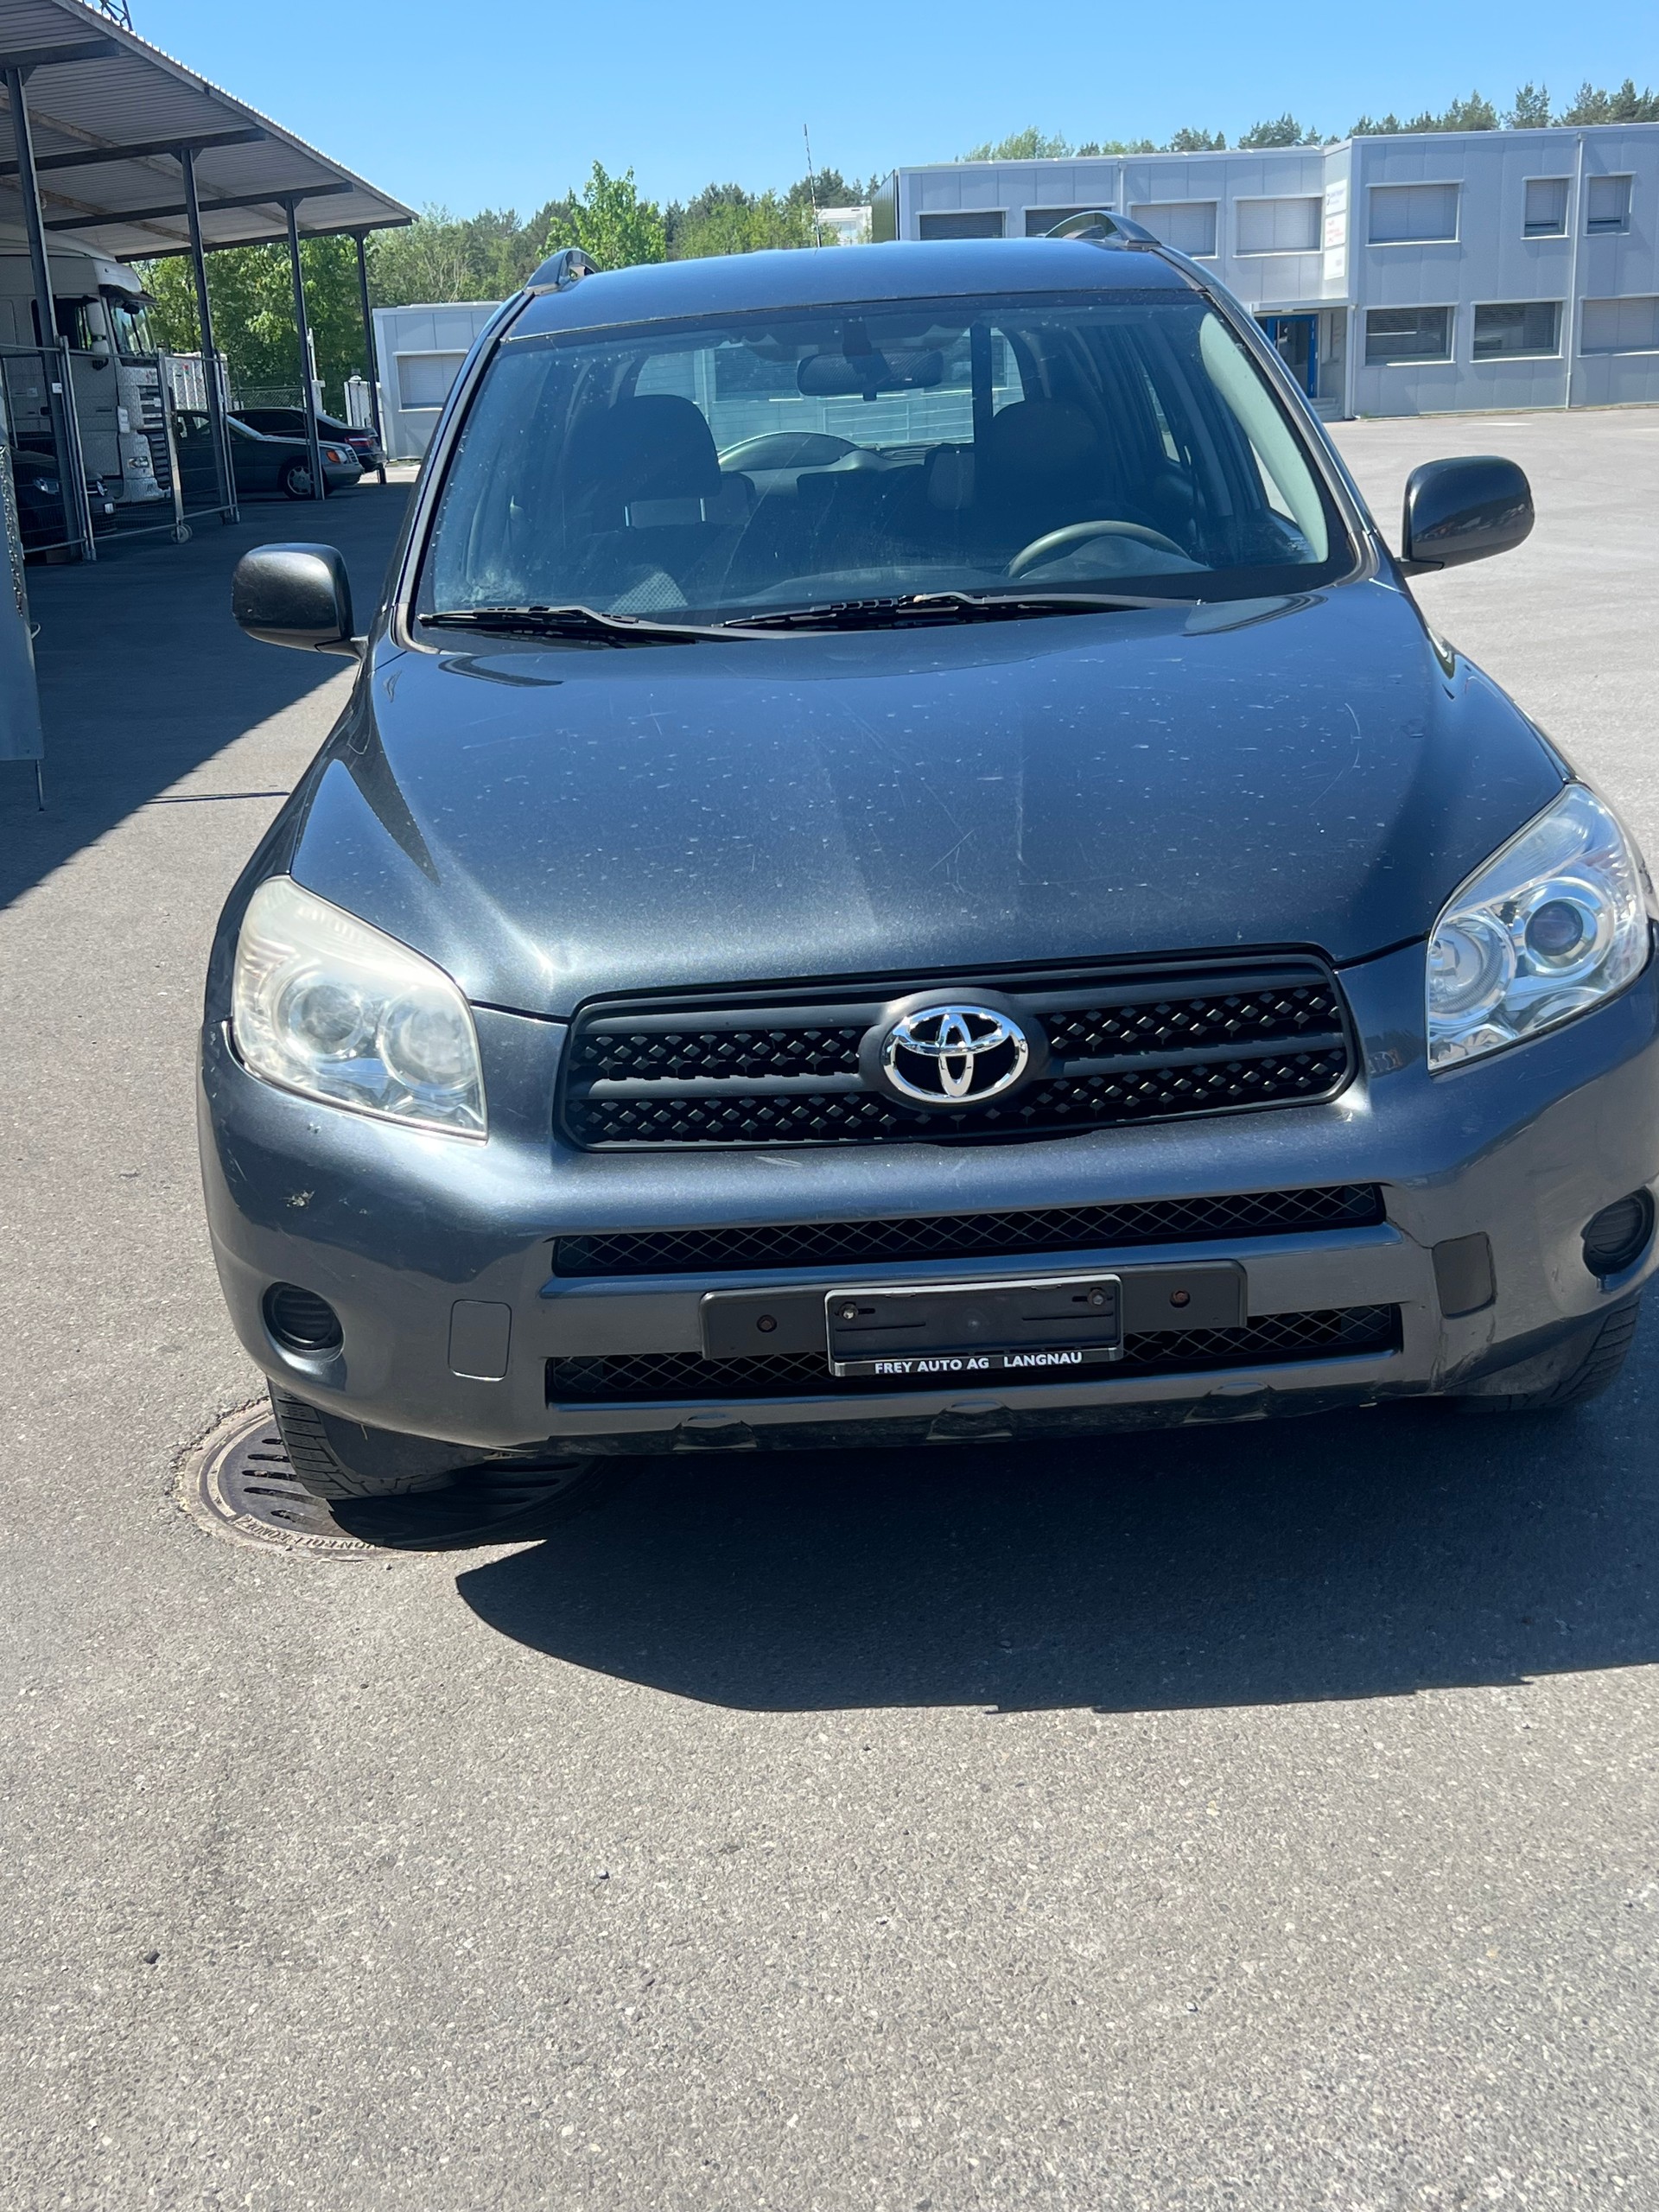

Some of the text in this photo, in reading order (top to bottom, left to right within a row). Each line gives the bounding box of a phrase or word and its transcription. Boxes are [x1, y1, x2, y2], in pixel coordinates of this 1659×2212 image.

[874, 1351, 1083, 1374] FREY AUTO AG LANGNAU
